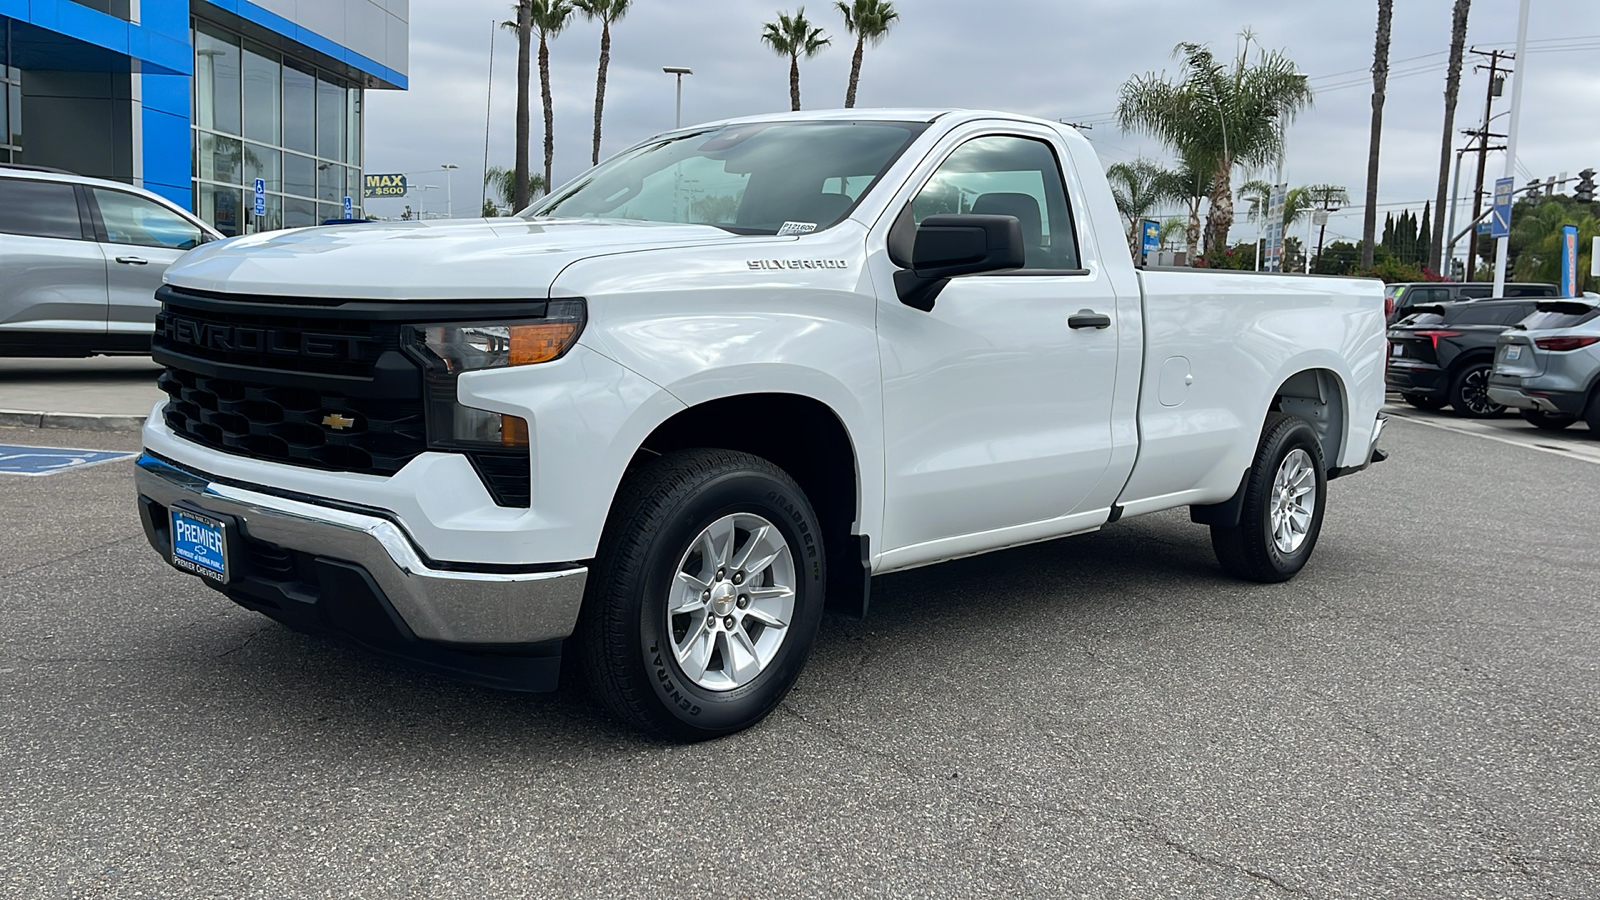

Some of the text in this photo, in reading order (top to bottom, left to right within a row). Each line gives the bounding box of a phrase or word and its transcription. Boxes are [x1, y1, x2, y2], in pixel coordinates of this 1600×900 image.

[366, 175, 403, 187] MAX
[375, 187, 404, 195] $500
[746, 259, 848, 270] SILVERADO
[155, 312, 378, 361] CHEVROLET
[176, 520, 223, 556] PREMIER
[174, 556, 223, 582] PREMIER CHEVROLET
[650, 640, 702, 716] GENERAL
